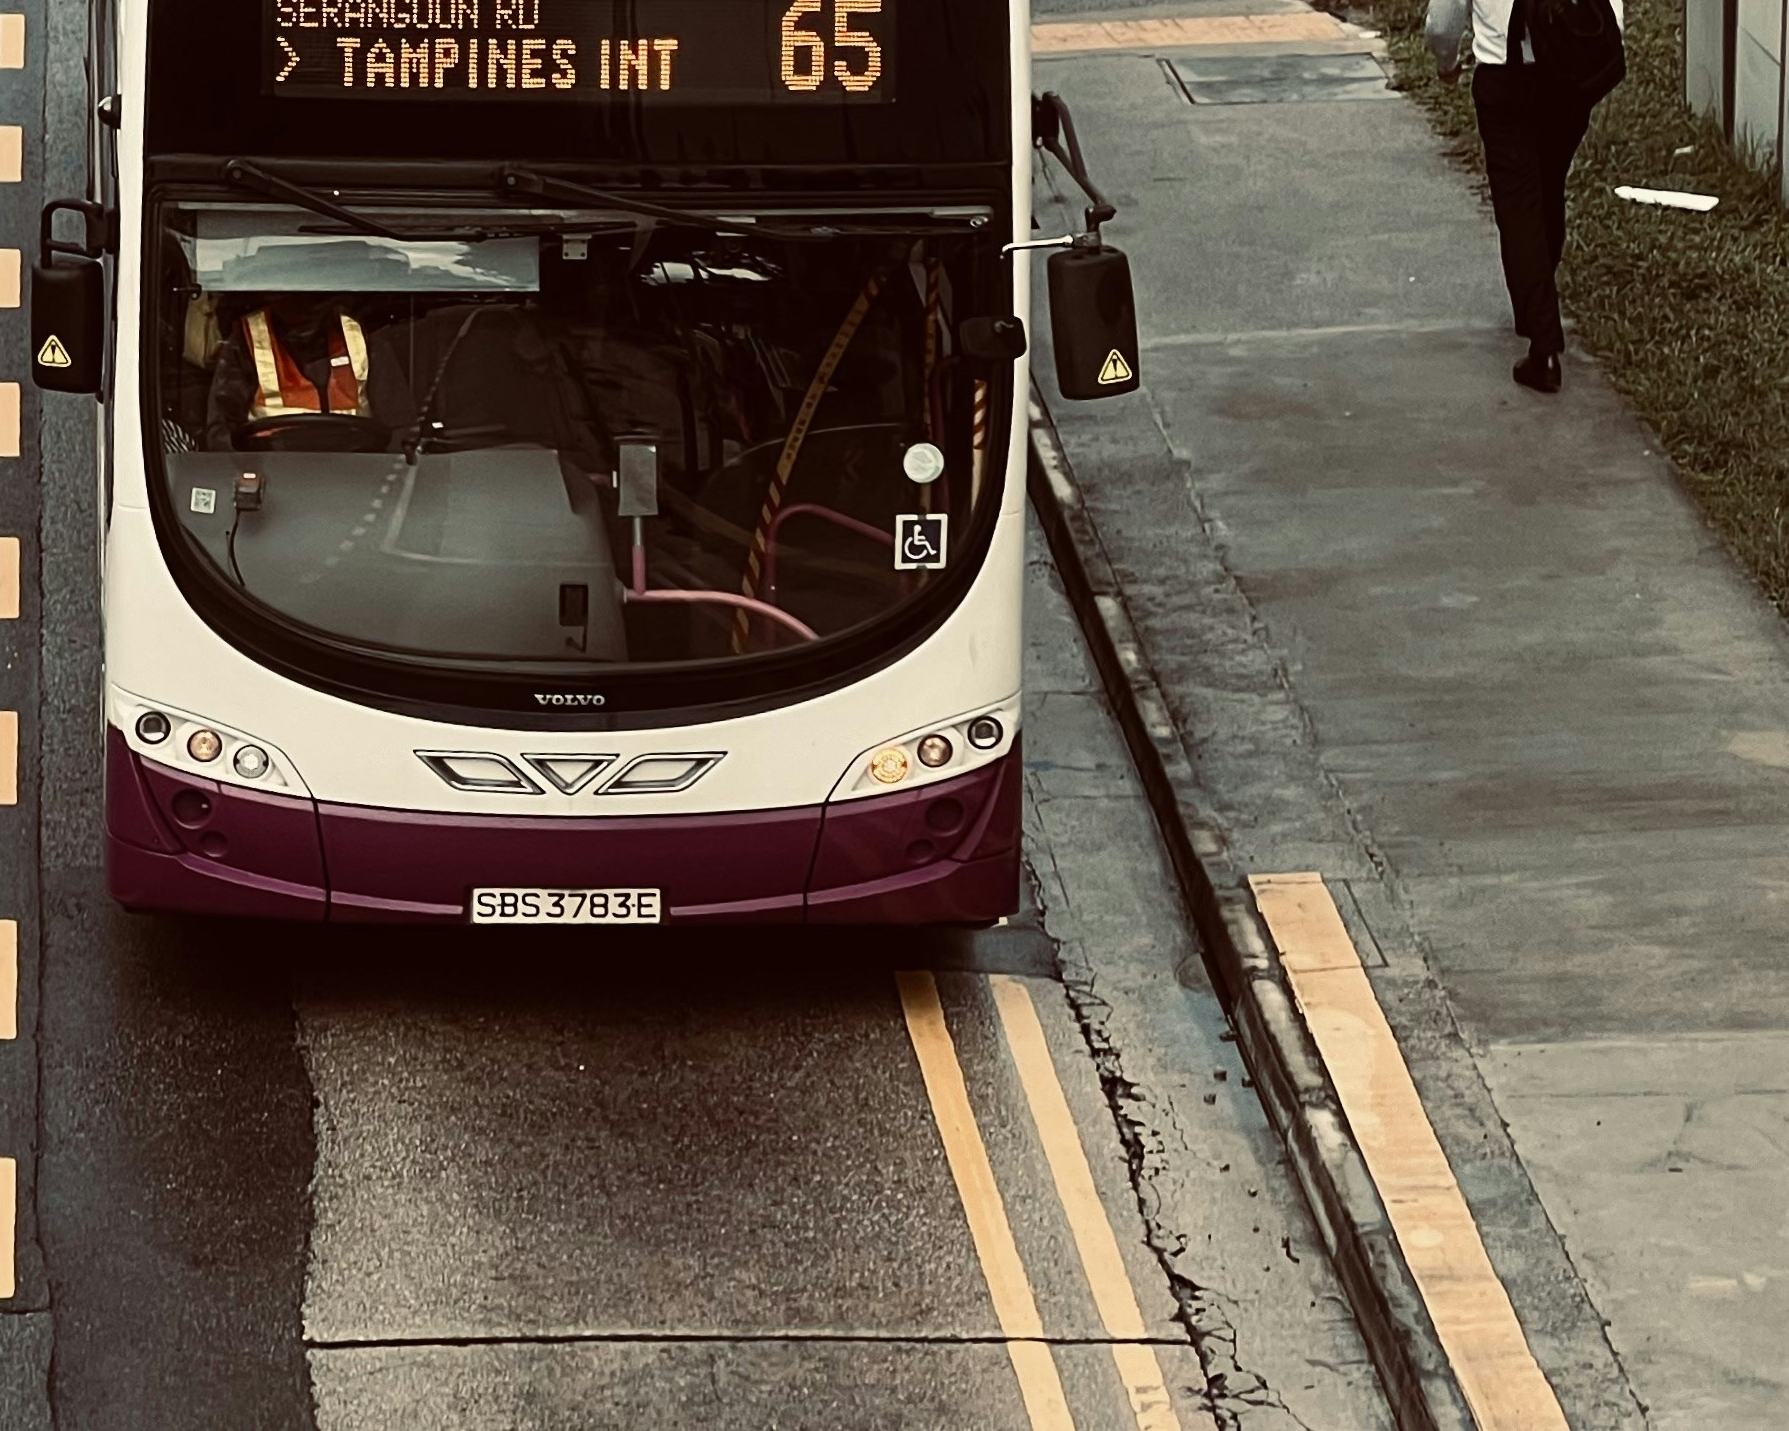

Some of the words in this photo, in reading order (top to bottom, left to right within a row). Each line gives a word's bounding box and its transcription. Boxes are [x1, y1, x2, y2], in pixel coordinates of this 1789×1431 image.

[336, 36, 577, 88] TAMPINES
[599, 38, 680, 91] INT
[533, 693, 606, 706] VOLVO
[476, 892, 658, 918] SBS3783E
